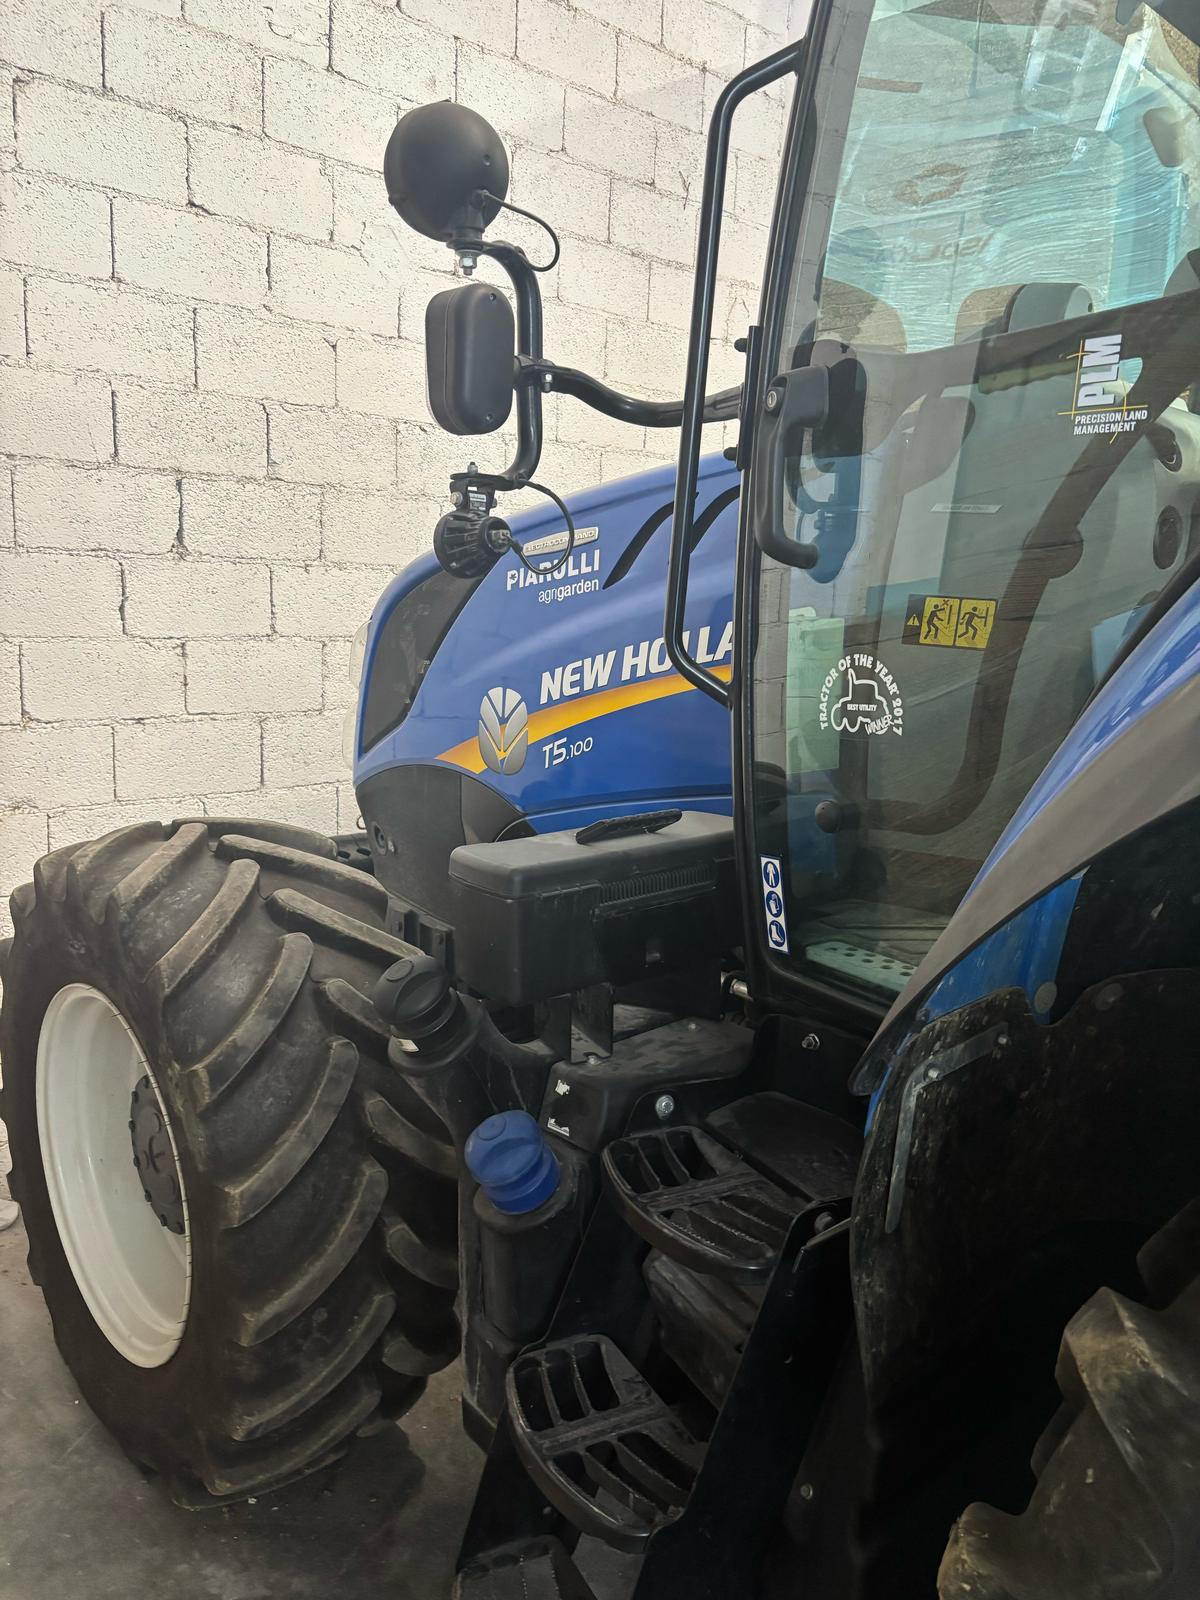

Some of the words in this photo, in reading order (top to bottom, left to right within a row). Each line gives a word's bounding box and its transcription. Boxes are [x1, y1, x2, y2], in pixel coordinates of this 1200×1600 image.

[1077, 334, 1123, 407] PLM
[1073, 421, 1137, 435] MANAGEMENT
[1074, 412, 1121, 425] PRECISION
[1124, 410, 1149, 421] LAND
[540, 650, 616, 705] NEW
[819, 668, 839, 730] TRACTOR
[838, 655, 851, 671] OF
[853, 653, 874, 669] THE
[892, 697, 904, 736] 2017
[846, 703, 858, 711] BEST
[865, 714, 895, 735] WINNER
[542, 737, 593, 769] T5.100
